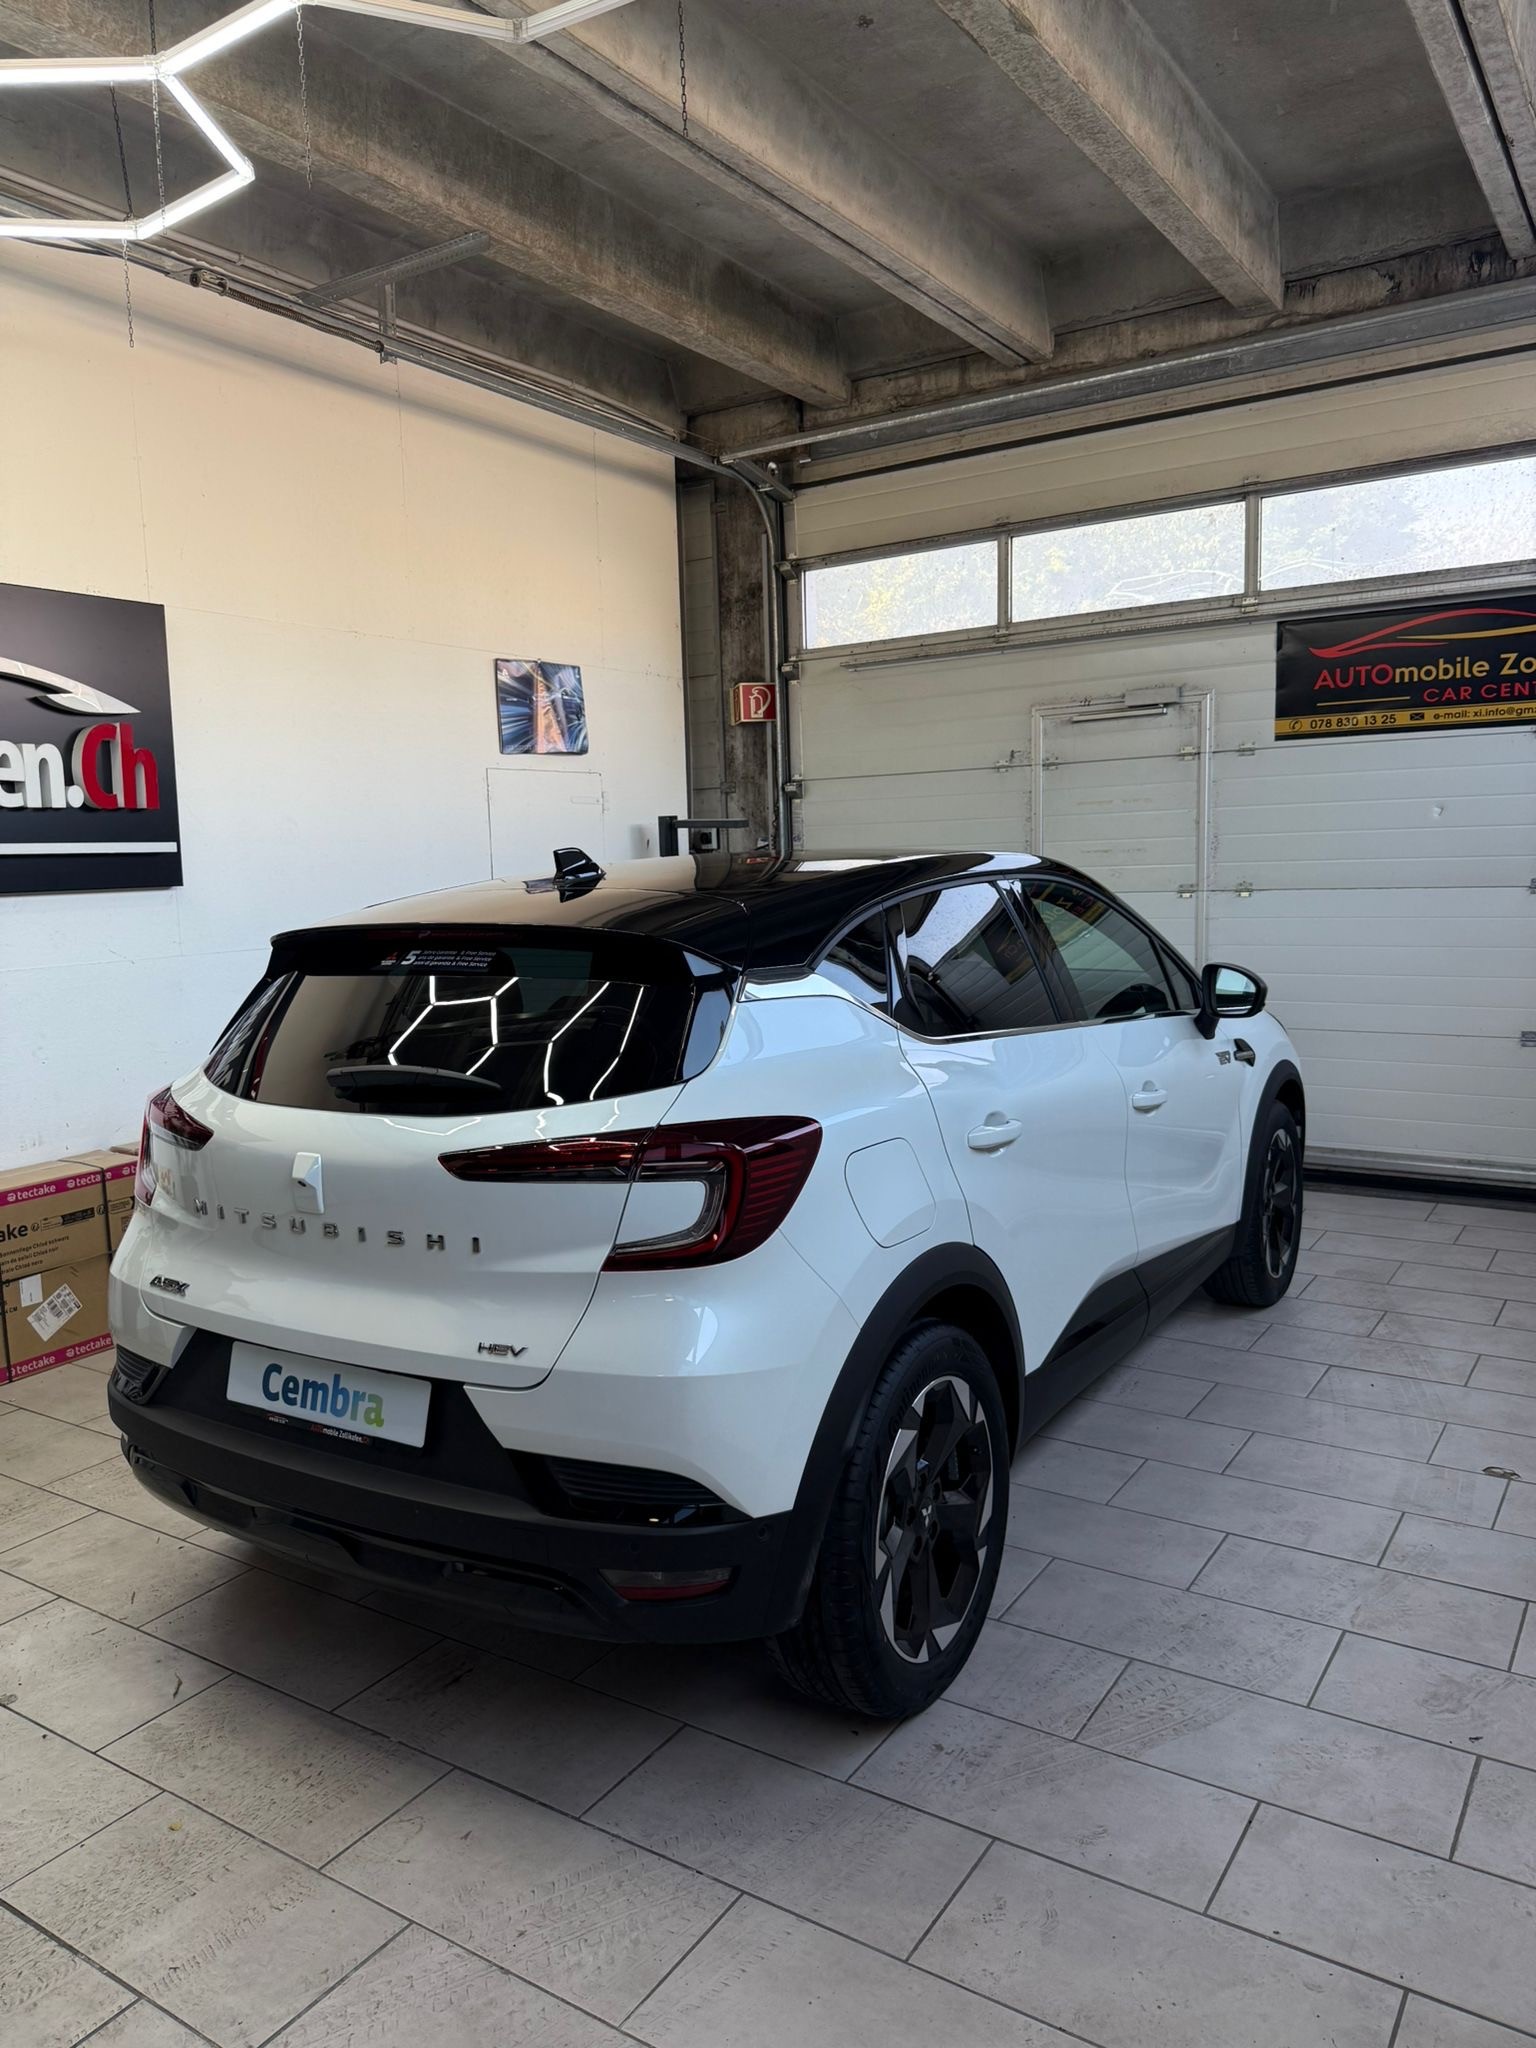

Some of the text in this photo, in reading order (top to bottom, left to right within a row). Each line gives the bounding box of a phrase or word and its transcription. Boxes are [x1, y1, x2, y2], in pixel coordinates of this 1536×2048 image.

[1313, 652, 1536, 690] AUTOmobile Zo
[1423, 686, 1471, 703] CAR
[1310, 718, 1333, 730] 078
[1336, 717, 1359, 728] 830
[1364, 715, 1377, 726] 13
[1381, 714, 1397, 724] 25
[1433, 709, 1471, 720] e-mail:
[400, 950, 422, 965] 5
[76, 1170, 113, 1186] tectae
[17, 1183, 57, 1200] tectake
[195, 1198, 482, 1255] MITSUBISHI
[149, 1274, 191, 1297] ASX
[75, 1336, 112, 1355] tectake
[477, 1342, 529, 1359] HEV
[16, 1355, 56, 1374] tectake
[261, 1363, 385, 1428] Cembra
